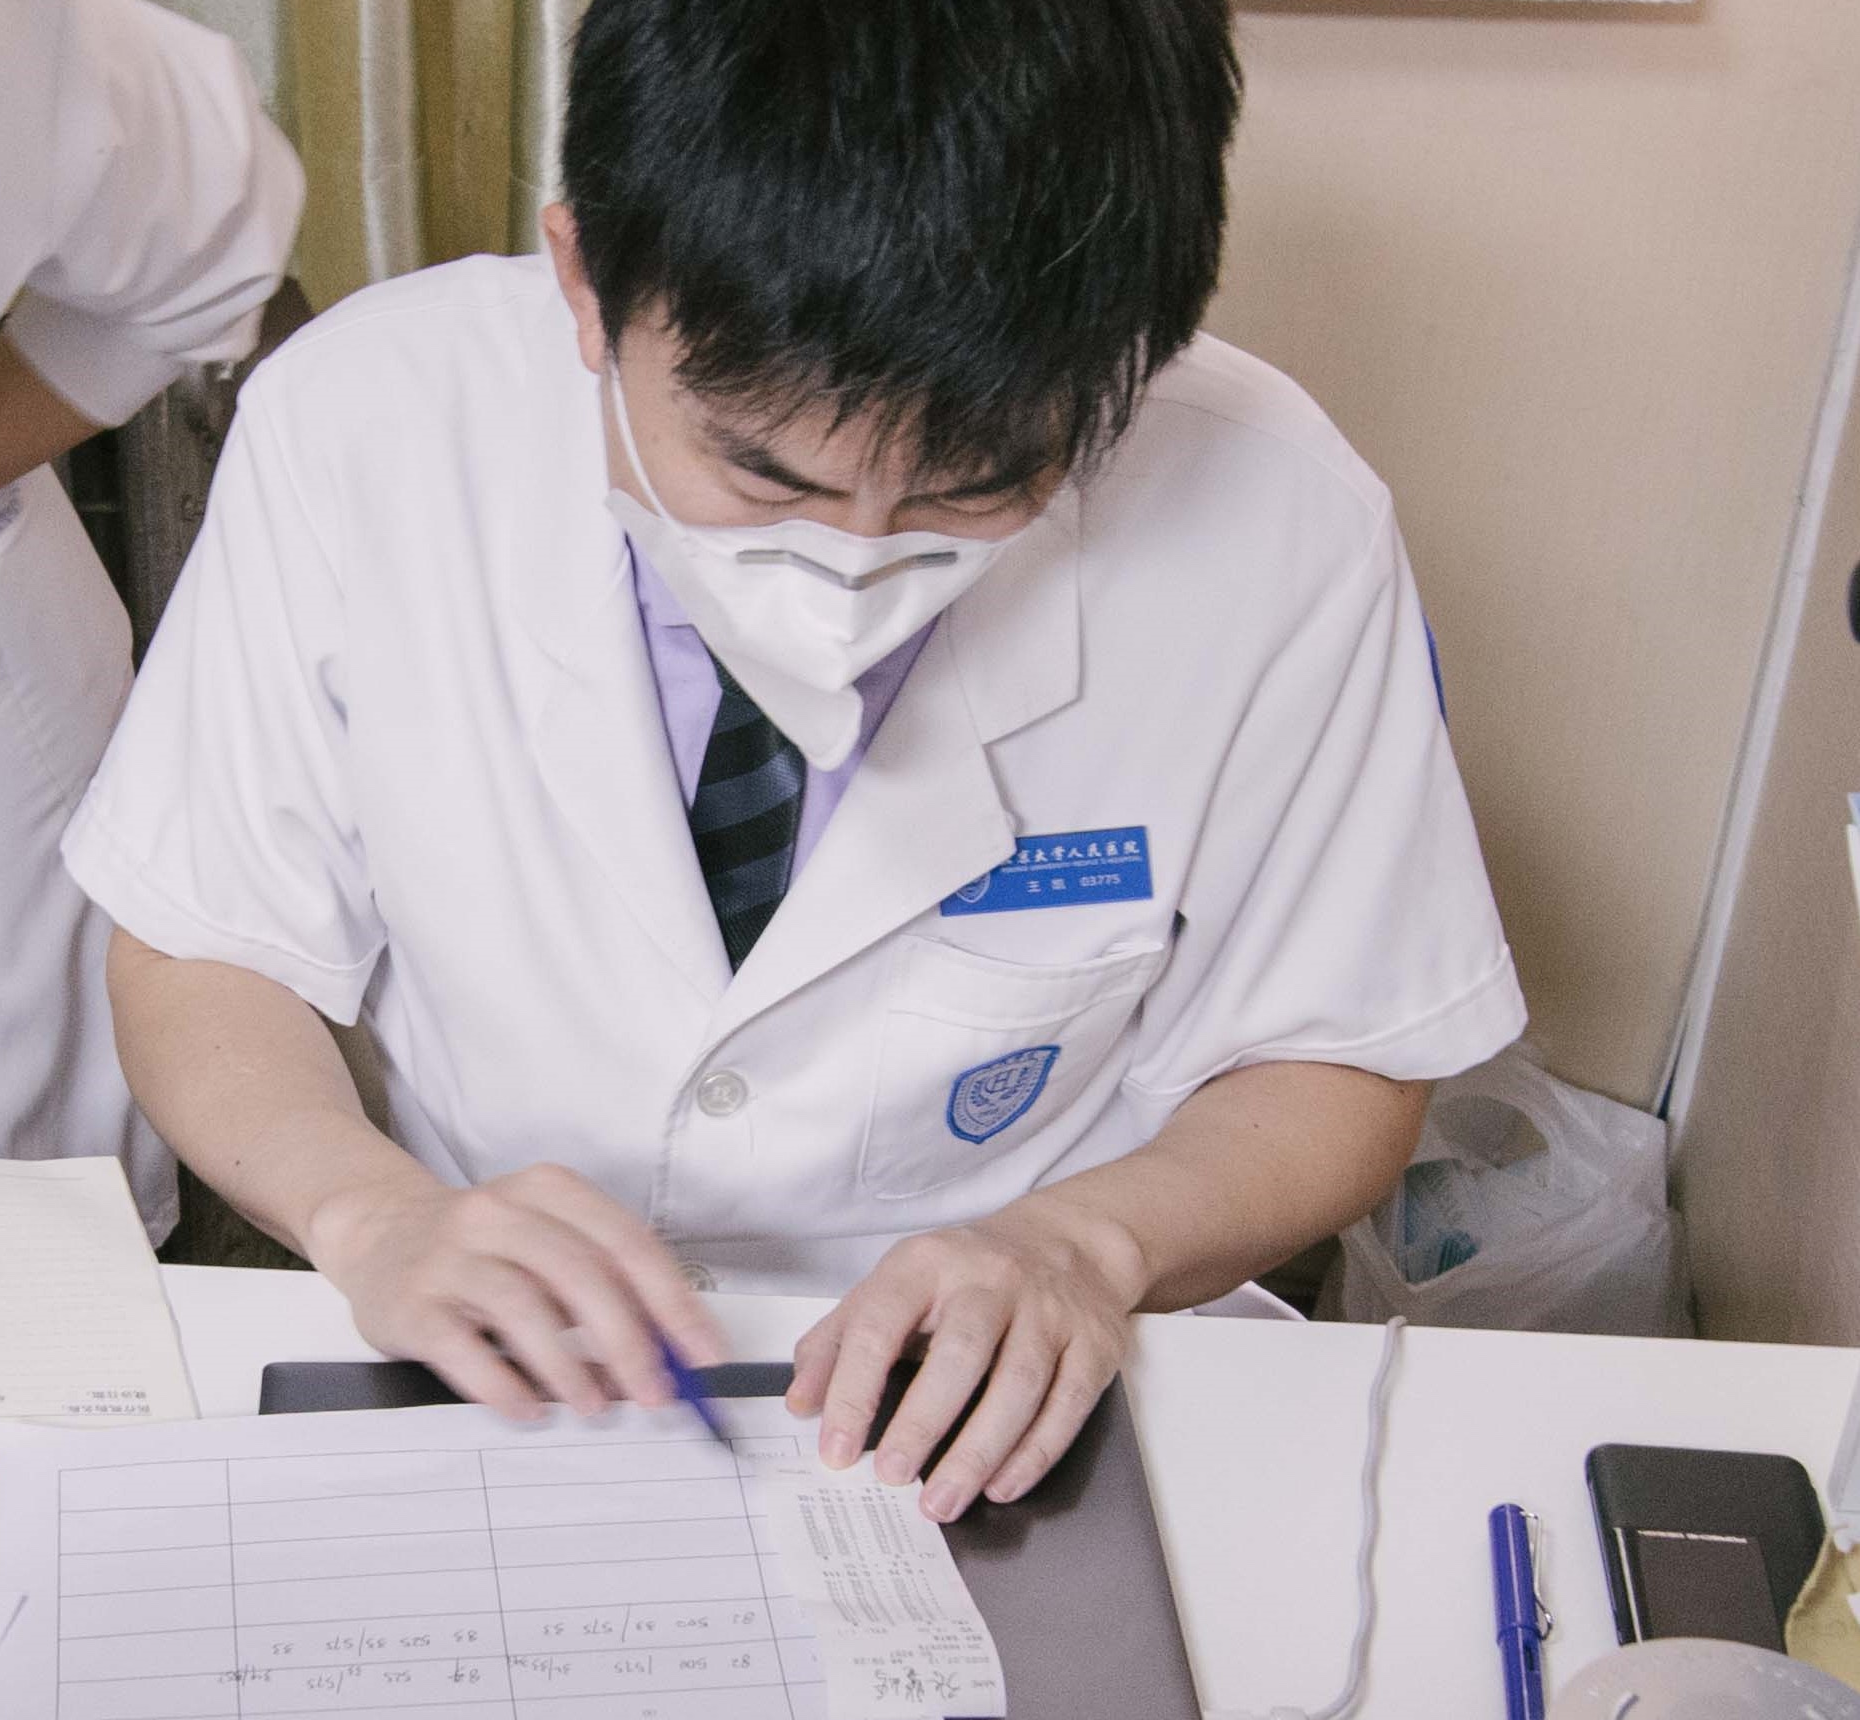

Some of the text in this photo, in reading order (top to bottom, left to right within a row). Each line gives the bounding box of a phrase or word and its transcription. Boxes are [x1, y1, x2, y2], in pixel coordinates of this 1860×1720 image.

[1003, 840, 1141, 865] 京大学人民医院
